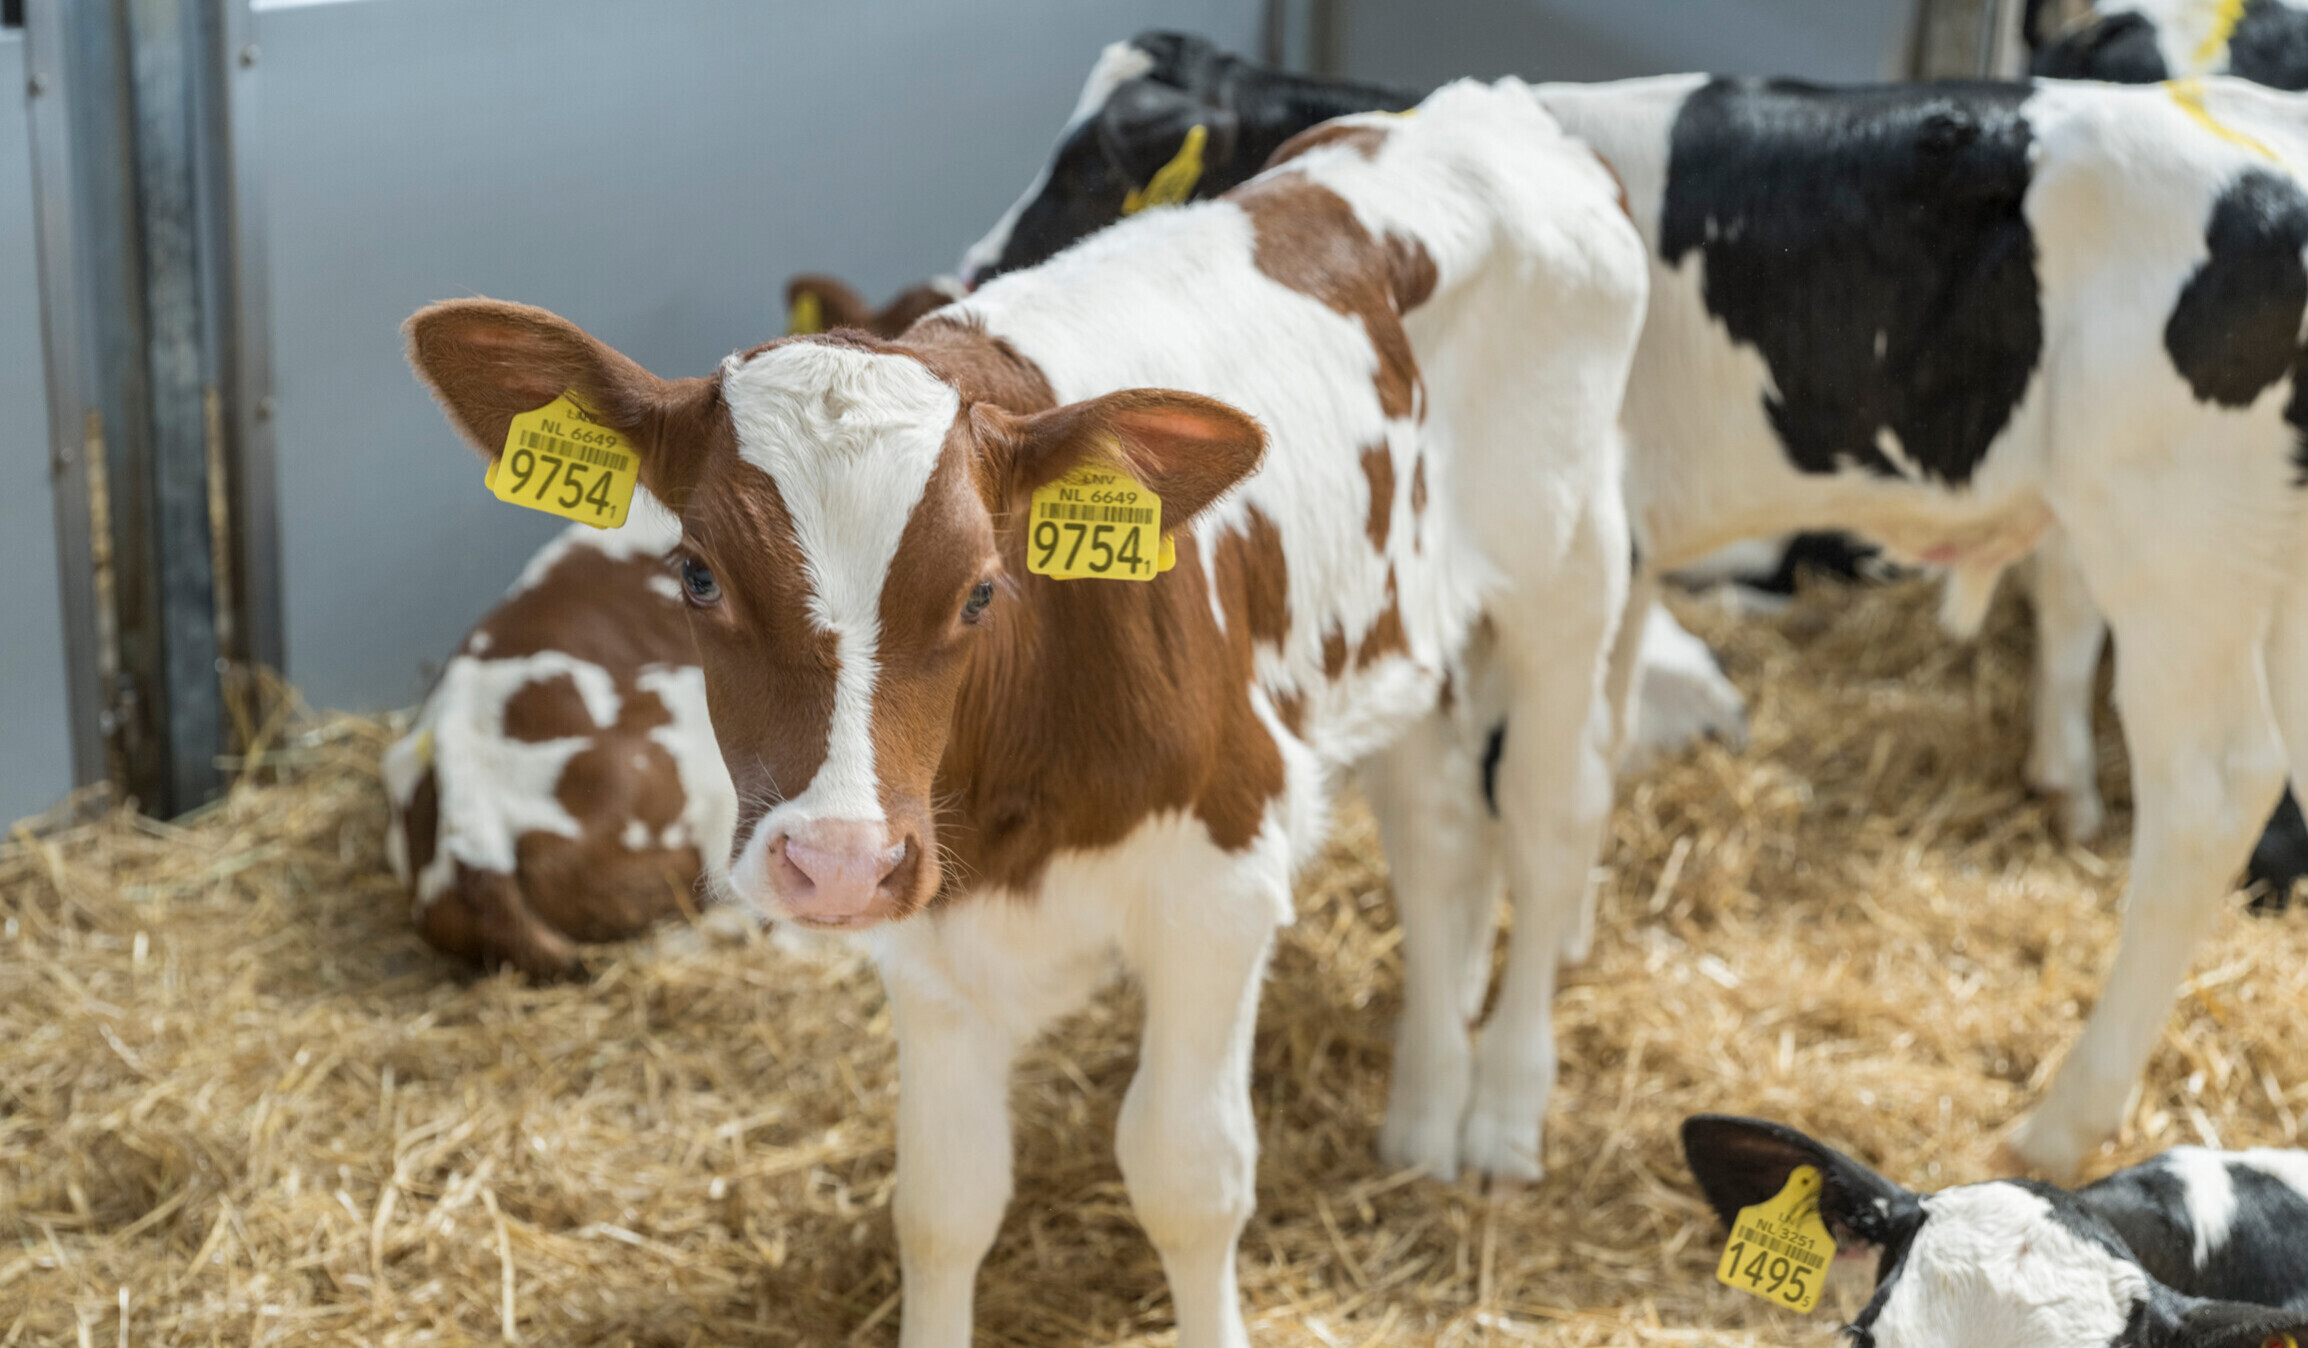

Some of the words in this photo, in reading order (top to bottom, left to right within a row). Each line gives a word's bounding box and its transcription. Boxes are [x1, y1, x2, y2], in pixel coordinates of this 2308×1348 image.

[541, 419, 565, 437] NL
[571, 428, 617, 448] 6649
[511, 448, 613, 516] 9754
[1060, 488, 1085, 502] NL
[1091, 490, 1138, 504] 6649
[1034, 521, 1143, 574] 9754
[1756, 1218, 1775, 1236] NL
[1779, 1228, 1815, 1250] 3251
[1730, 1241, 1812, 1303] 1495
